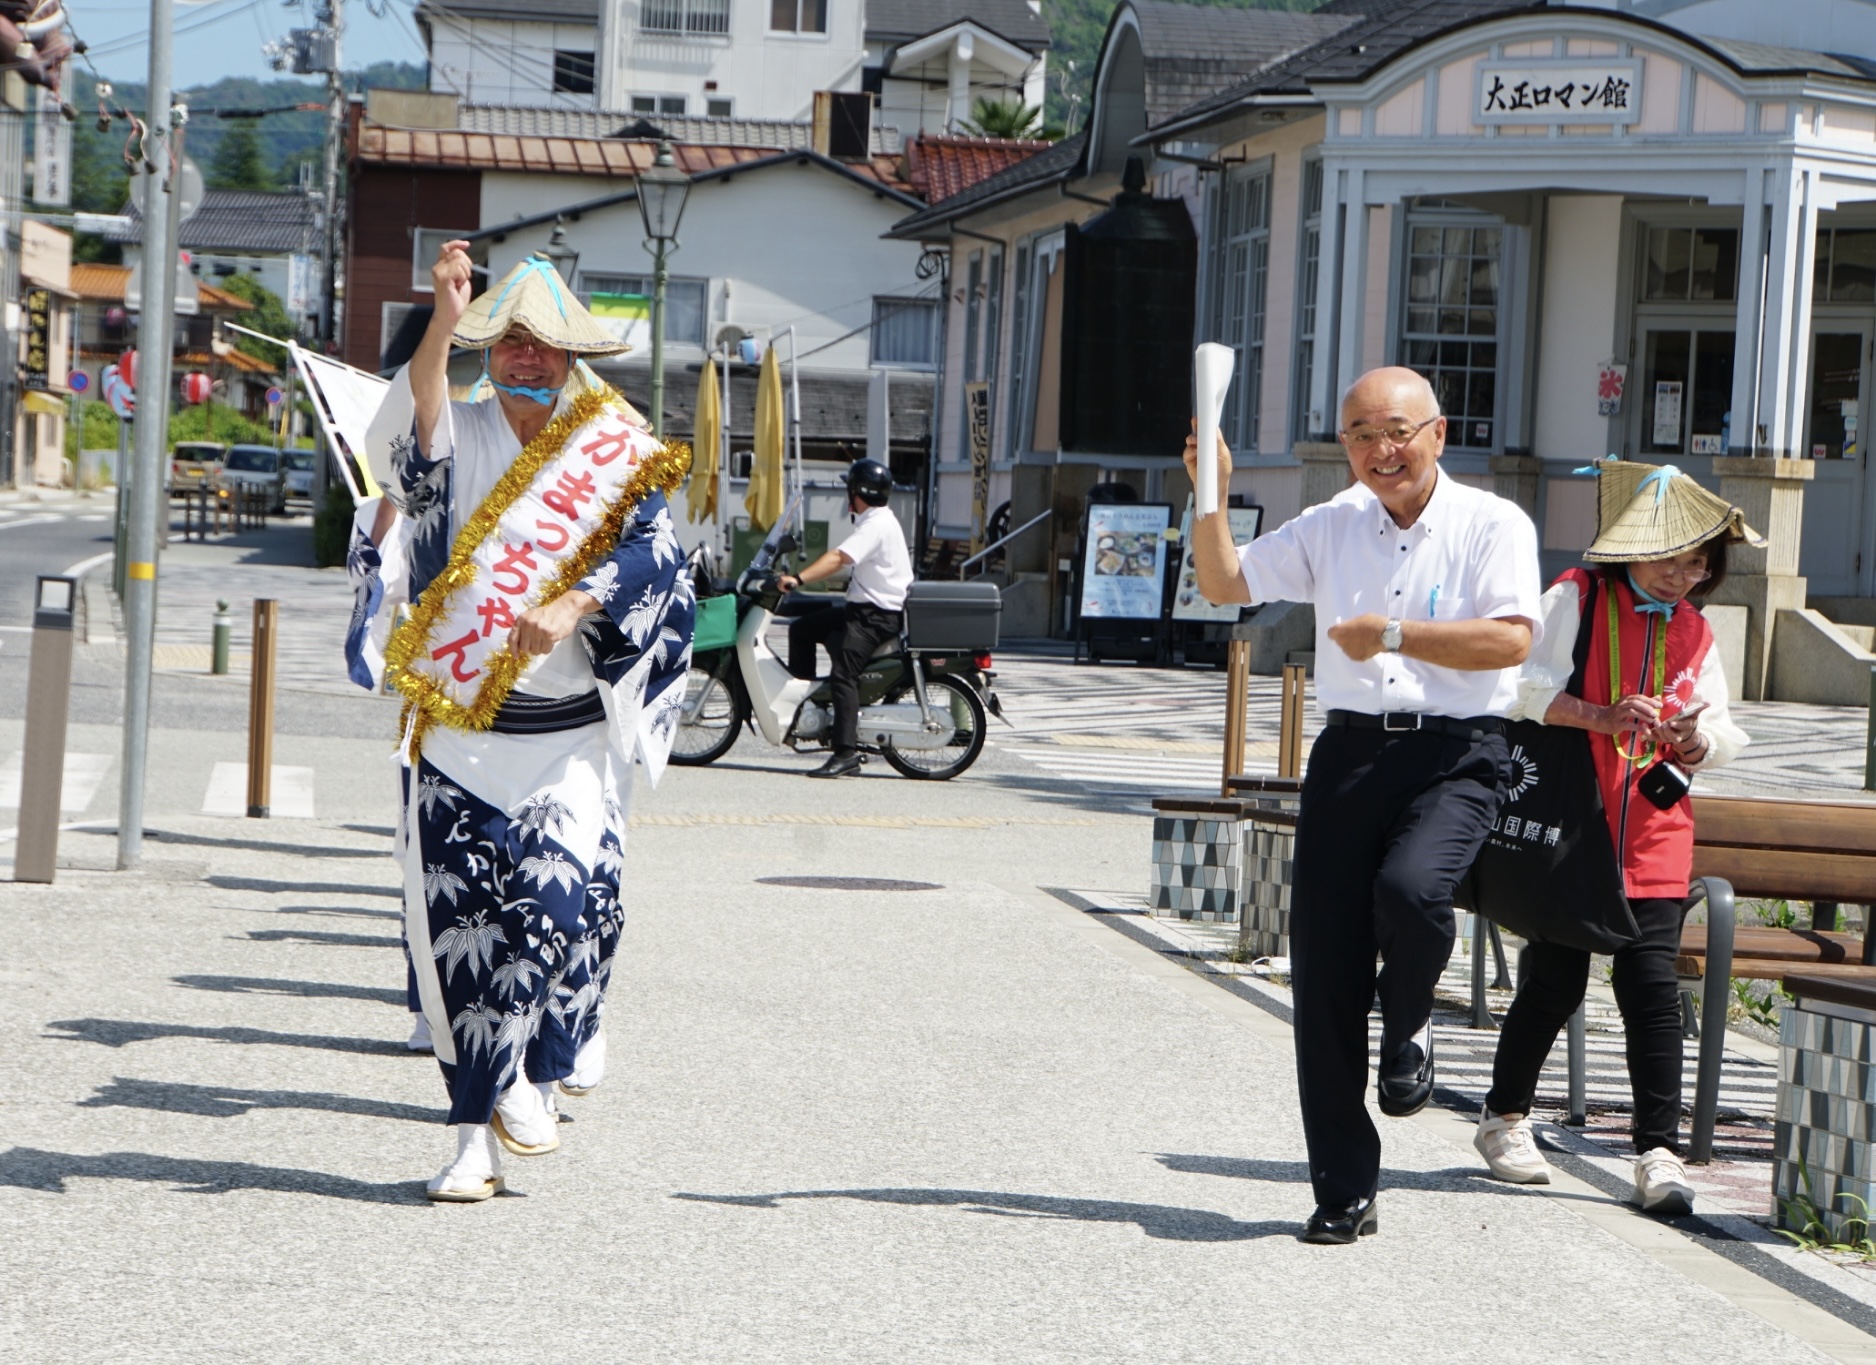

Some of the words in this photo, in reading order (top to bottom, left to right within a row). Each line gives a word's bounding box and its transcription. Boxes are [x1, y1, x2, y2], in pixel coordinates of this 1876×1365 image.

[1485, 75, 1630, 111] 大正ロマン館
